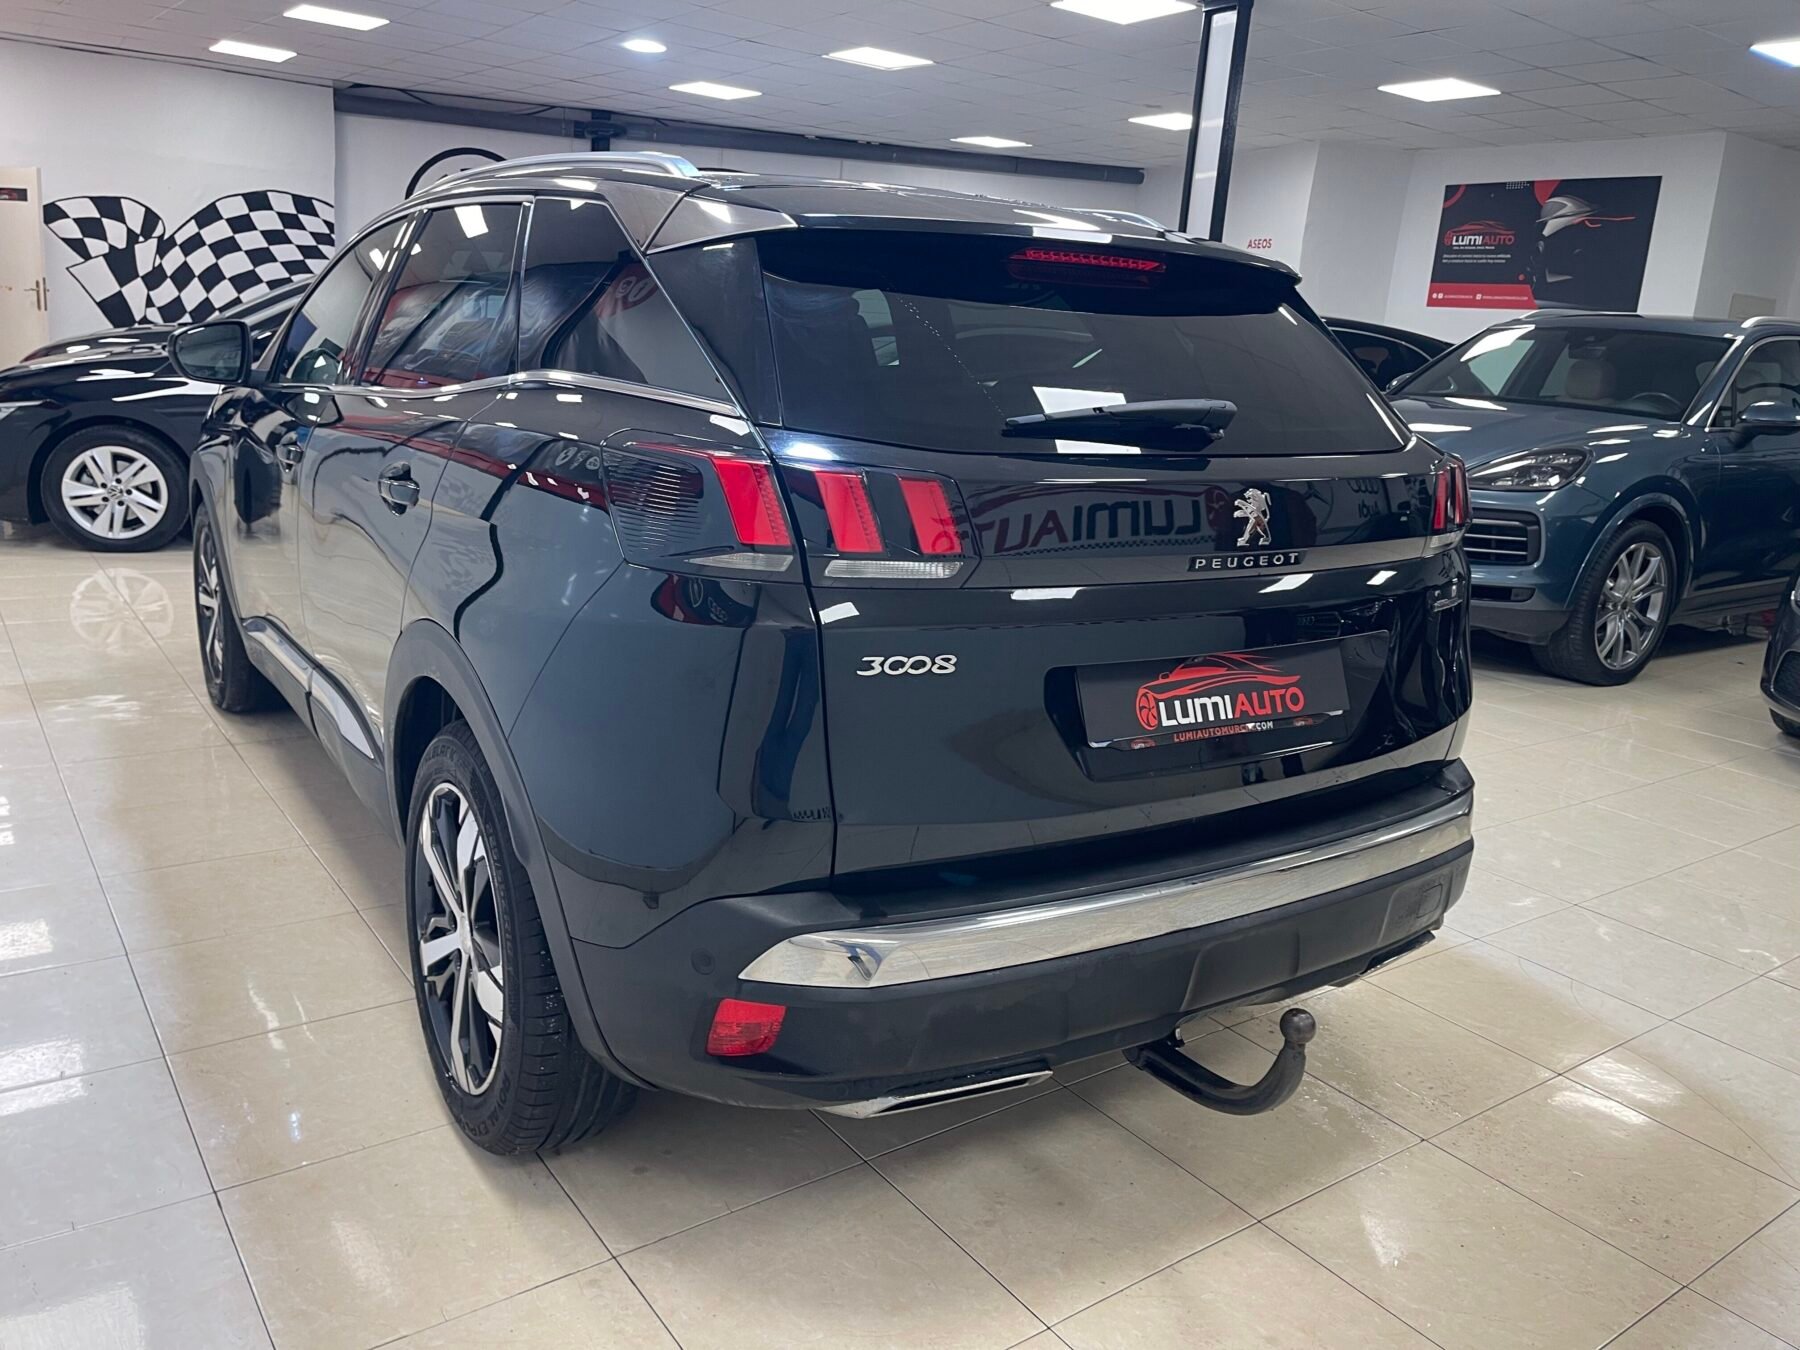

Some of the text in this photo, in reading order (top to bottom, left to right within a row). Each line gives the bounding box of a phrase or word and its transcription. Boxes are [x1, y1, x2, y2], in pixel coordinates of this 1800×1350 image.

[1247, 238, 1273, 249] ASEOS
[1195, 552, 1299, 570] PEUGEOT
[856, 654, 958, 676] 3008
[1159, 686, 1305, 727] LUMIAUTO
[1173, 720, 1274, 742] LUMIAUTOMURCI.COM
